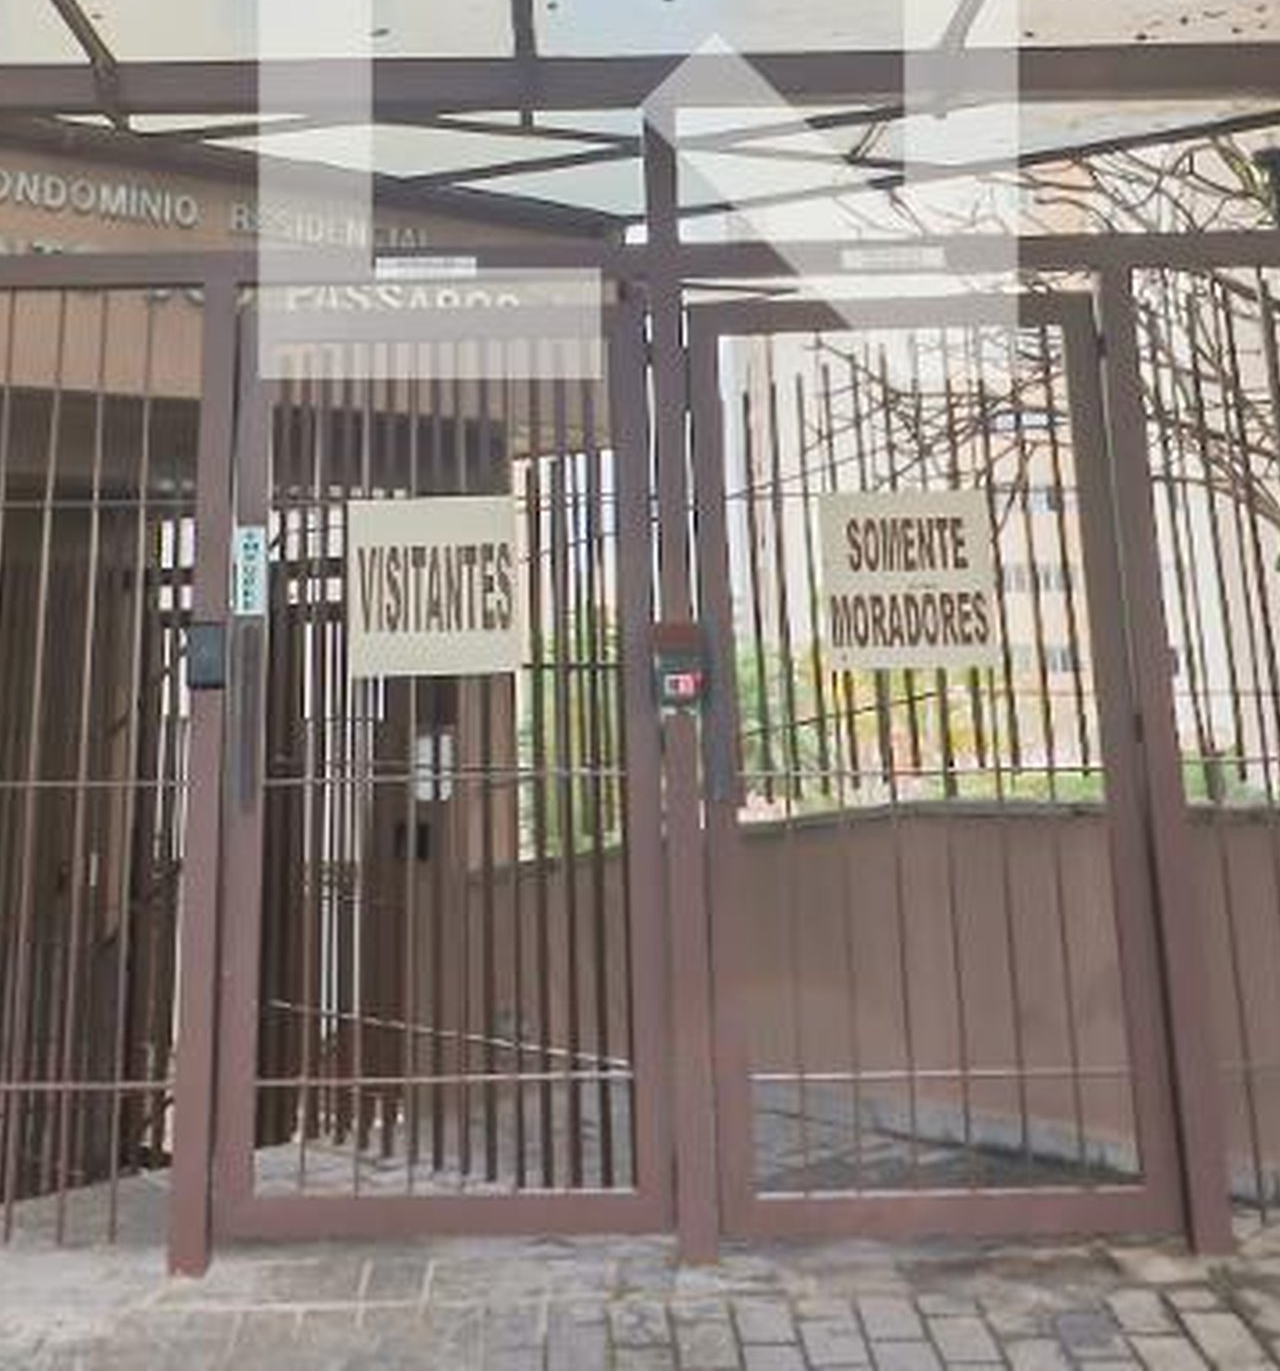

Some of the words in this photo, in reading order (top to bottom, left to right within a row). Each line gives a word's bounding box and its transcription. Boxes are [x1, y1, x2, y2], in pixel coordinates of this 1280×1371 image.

[846, 517, 970, 573] SOMENTE
[356, 542, 514, 634] VISITANTES
[830, 592, 990, 648] MORADORES
